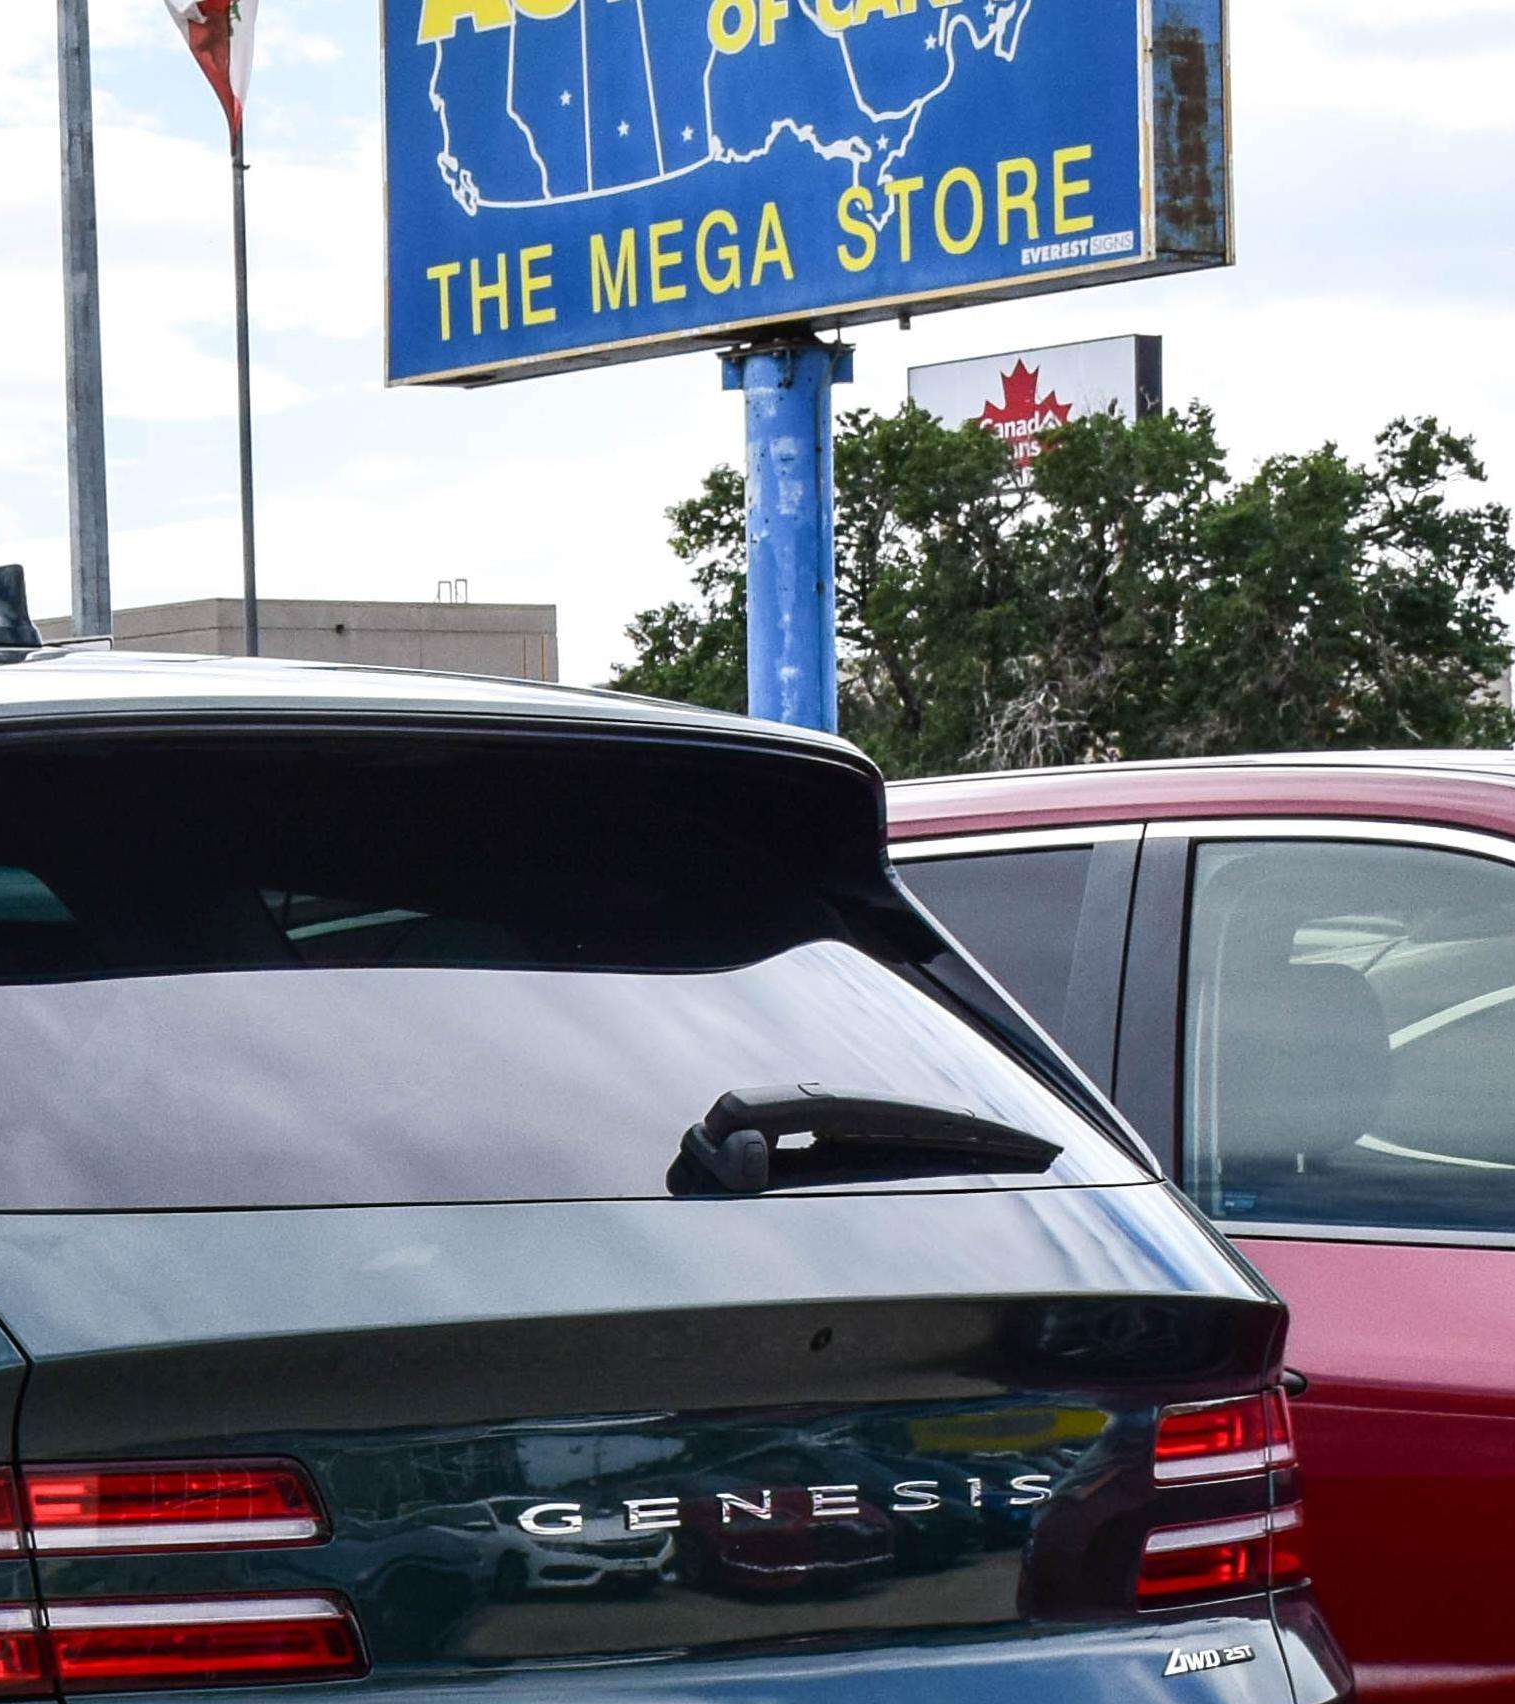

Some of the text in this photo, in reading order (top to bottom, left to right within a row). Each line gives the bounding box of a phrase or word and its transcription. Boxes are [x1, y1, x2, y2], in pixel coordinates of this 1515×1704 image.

[427, 144, 1096, 342] THE MEGA STORE
[1021, 232, 1133, 266] EVEREST SIGNS
[517, 1473, 1054, 1537] GENESIS
[1163, 1647, 1221, 1676] AWD
